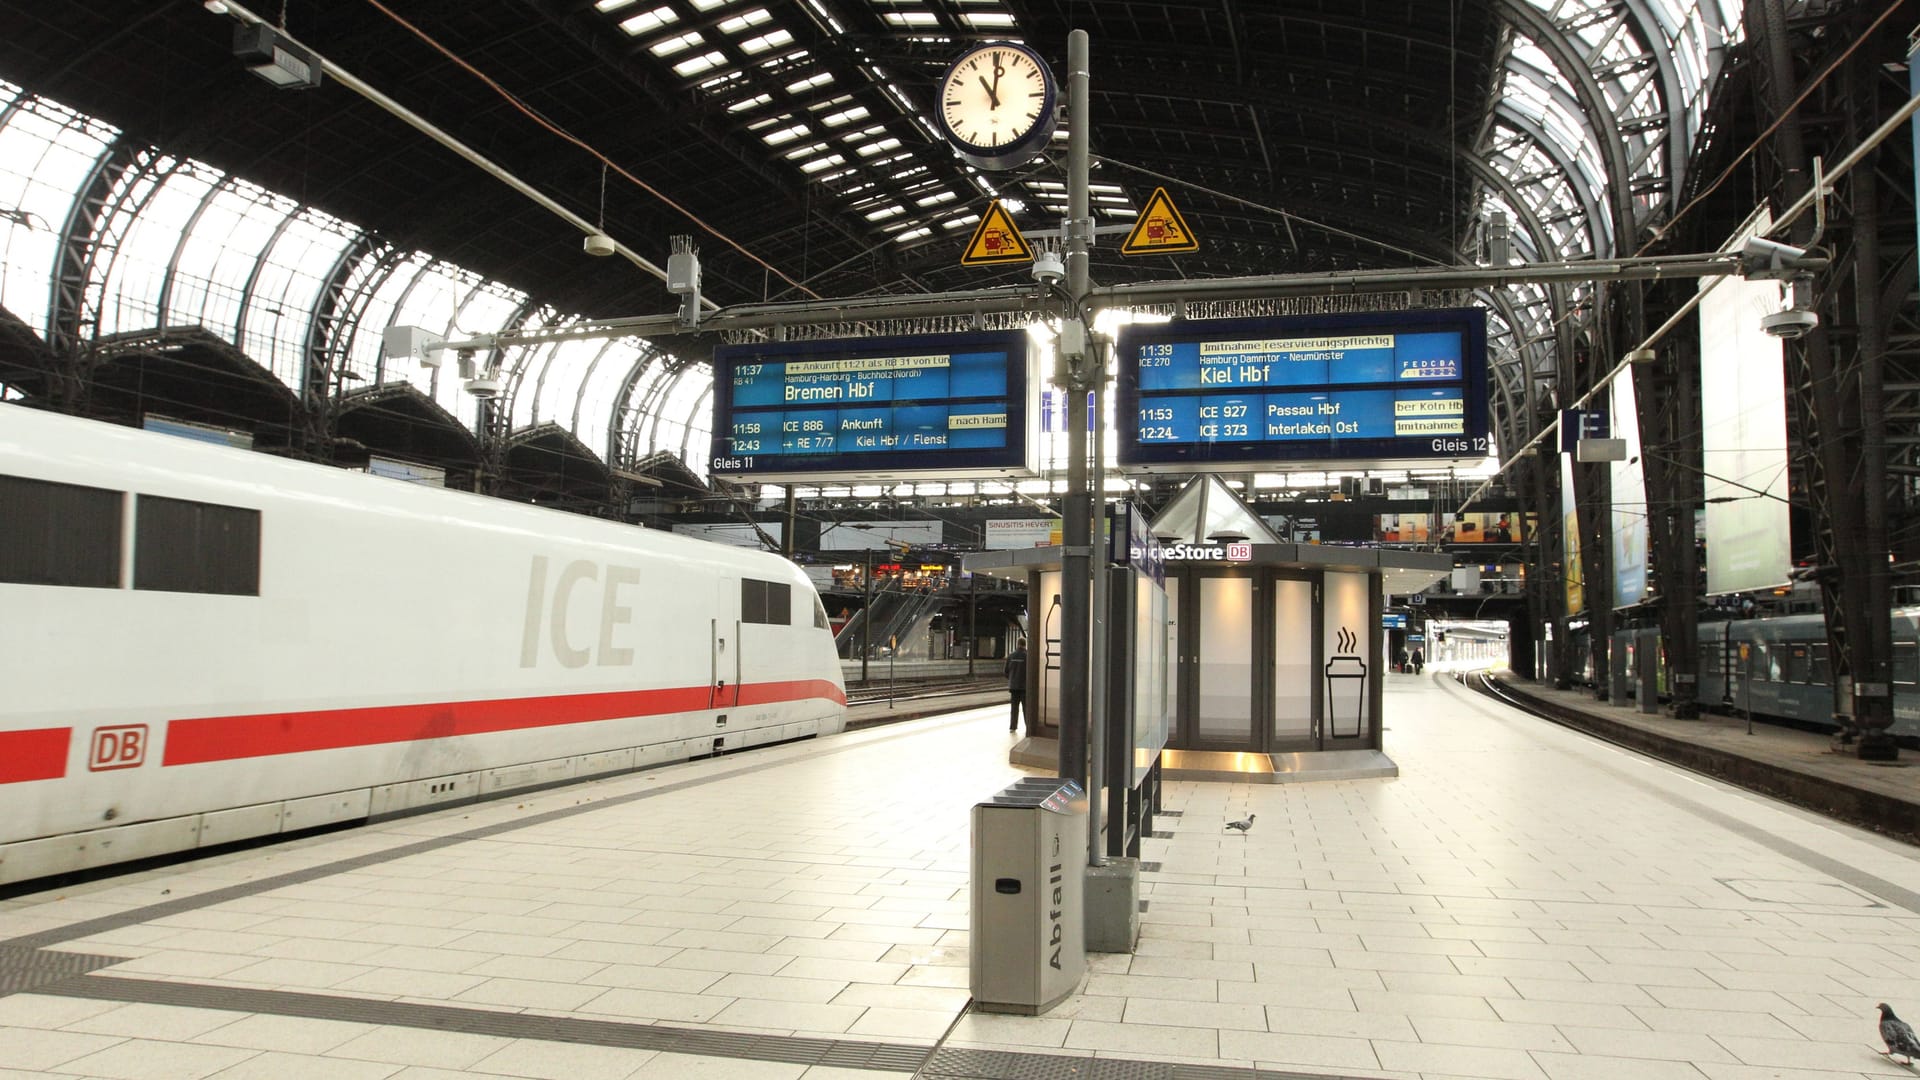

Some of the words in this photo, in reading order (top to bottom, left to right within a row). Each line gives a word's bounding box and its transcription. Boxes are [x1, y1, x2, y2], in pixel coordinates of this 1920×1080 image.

[1264, 337, 1390, 350] reservierungspflichtig
[1140, 344, 1173, 356] 11:39
[803, 361, 840, 370] Ankunft
[843, 359, 865, 369] 11:21
[868, 360, 882, 368] als
[885, 359, 897, 367] RB
[900, 358, 910, 366] 31
[1139, 359, 1152, 367] ICE
[1154, 358, 1170, 366] 270
[1199, 355, 1238, 365] Hamburg
[1241, 354, 1280, 364] Dammtor
[1289, 351, 1345, 361] Neumünster
[735, 365, 762, 376] 11:37
[1201, 367, 1232, 384] Kiel
[1240, 366, 1270, 382] Hbf
[733, 378, 743, 386] RB
[785, 373, 850, 384] Hamburg-Harburg
[785, 386, 842, 400] Bremen
[848, 382, 874, 397] Hbf
[1140, 409, 1173, 420] 11:53
[1200, 407, 1218, 418] ICE
[1223, 406, 1247, 417] 927
[1268, 404, 1313, 416] Passau
[1318, 403, 1340, 414] Hbf
[783, 421, 799, 432] ICE
[803, 420, 823, 431] 886
[841, 418, 882, 430] Ankunft
[956, 417, 979, 425] nach
[732, 424, 760, 434] 11:58
[1140, 427, 1172, 438] 12:24
[1200, 425, 1218, 436] ICE
[1223, 424, 1248, 436] 373
[1268, 423, 1330, 435] Interlaken
[1336, 421, 1358, 433] Ost
[732, 440, 760, 451] 12:43
[797, 438, 810, 449] RE
[856, 436, 875, 446] Kiel
[880, 435, 899, 446] Hbf
[1432, 438, 1468, 452] Gleis
[1473, 438, 1486, 451] 12
[713, 458, 741, 469] Gleis
[744, 457, 753, 468] 11
[519, 554, 641, 669] ICE
[97, 731, 141, 764] DB
[1050, 864, 1062, 970] Abfall
